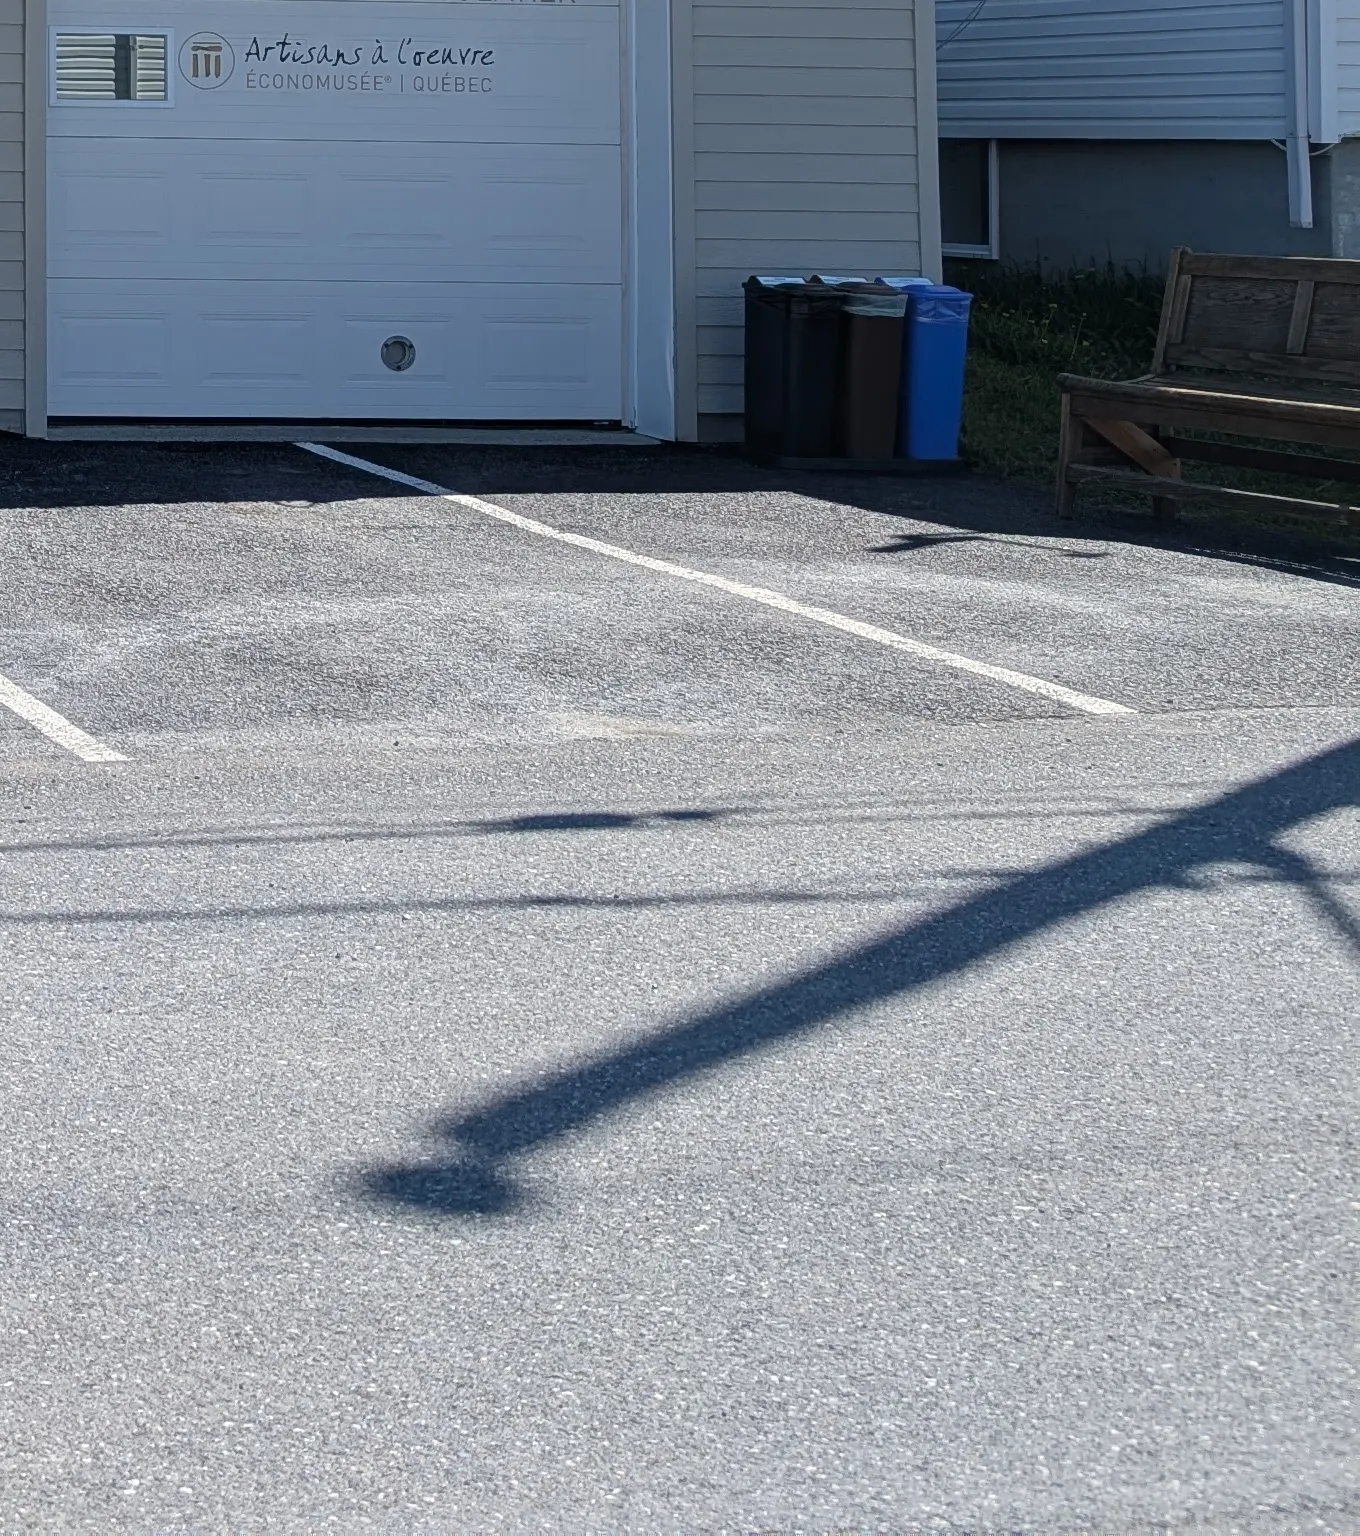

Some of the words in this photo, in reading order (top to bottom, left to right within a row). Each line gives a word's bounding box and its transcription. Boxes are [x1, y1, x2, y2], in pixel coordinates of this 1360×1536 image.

[244, 32, 364, 67] Artisans
[371, 38, 389, 66] à
[412, 71, 493, 93] QUÉBEC
